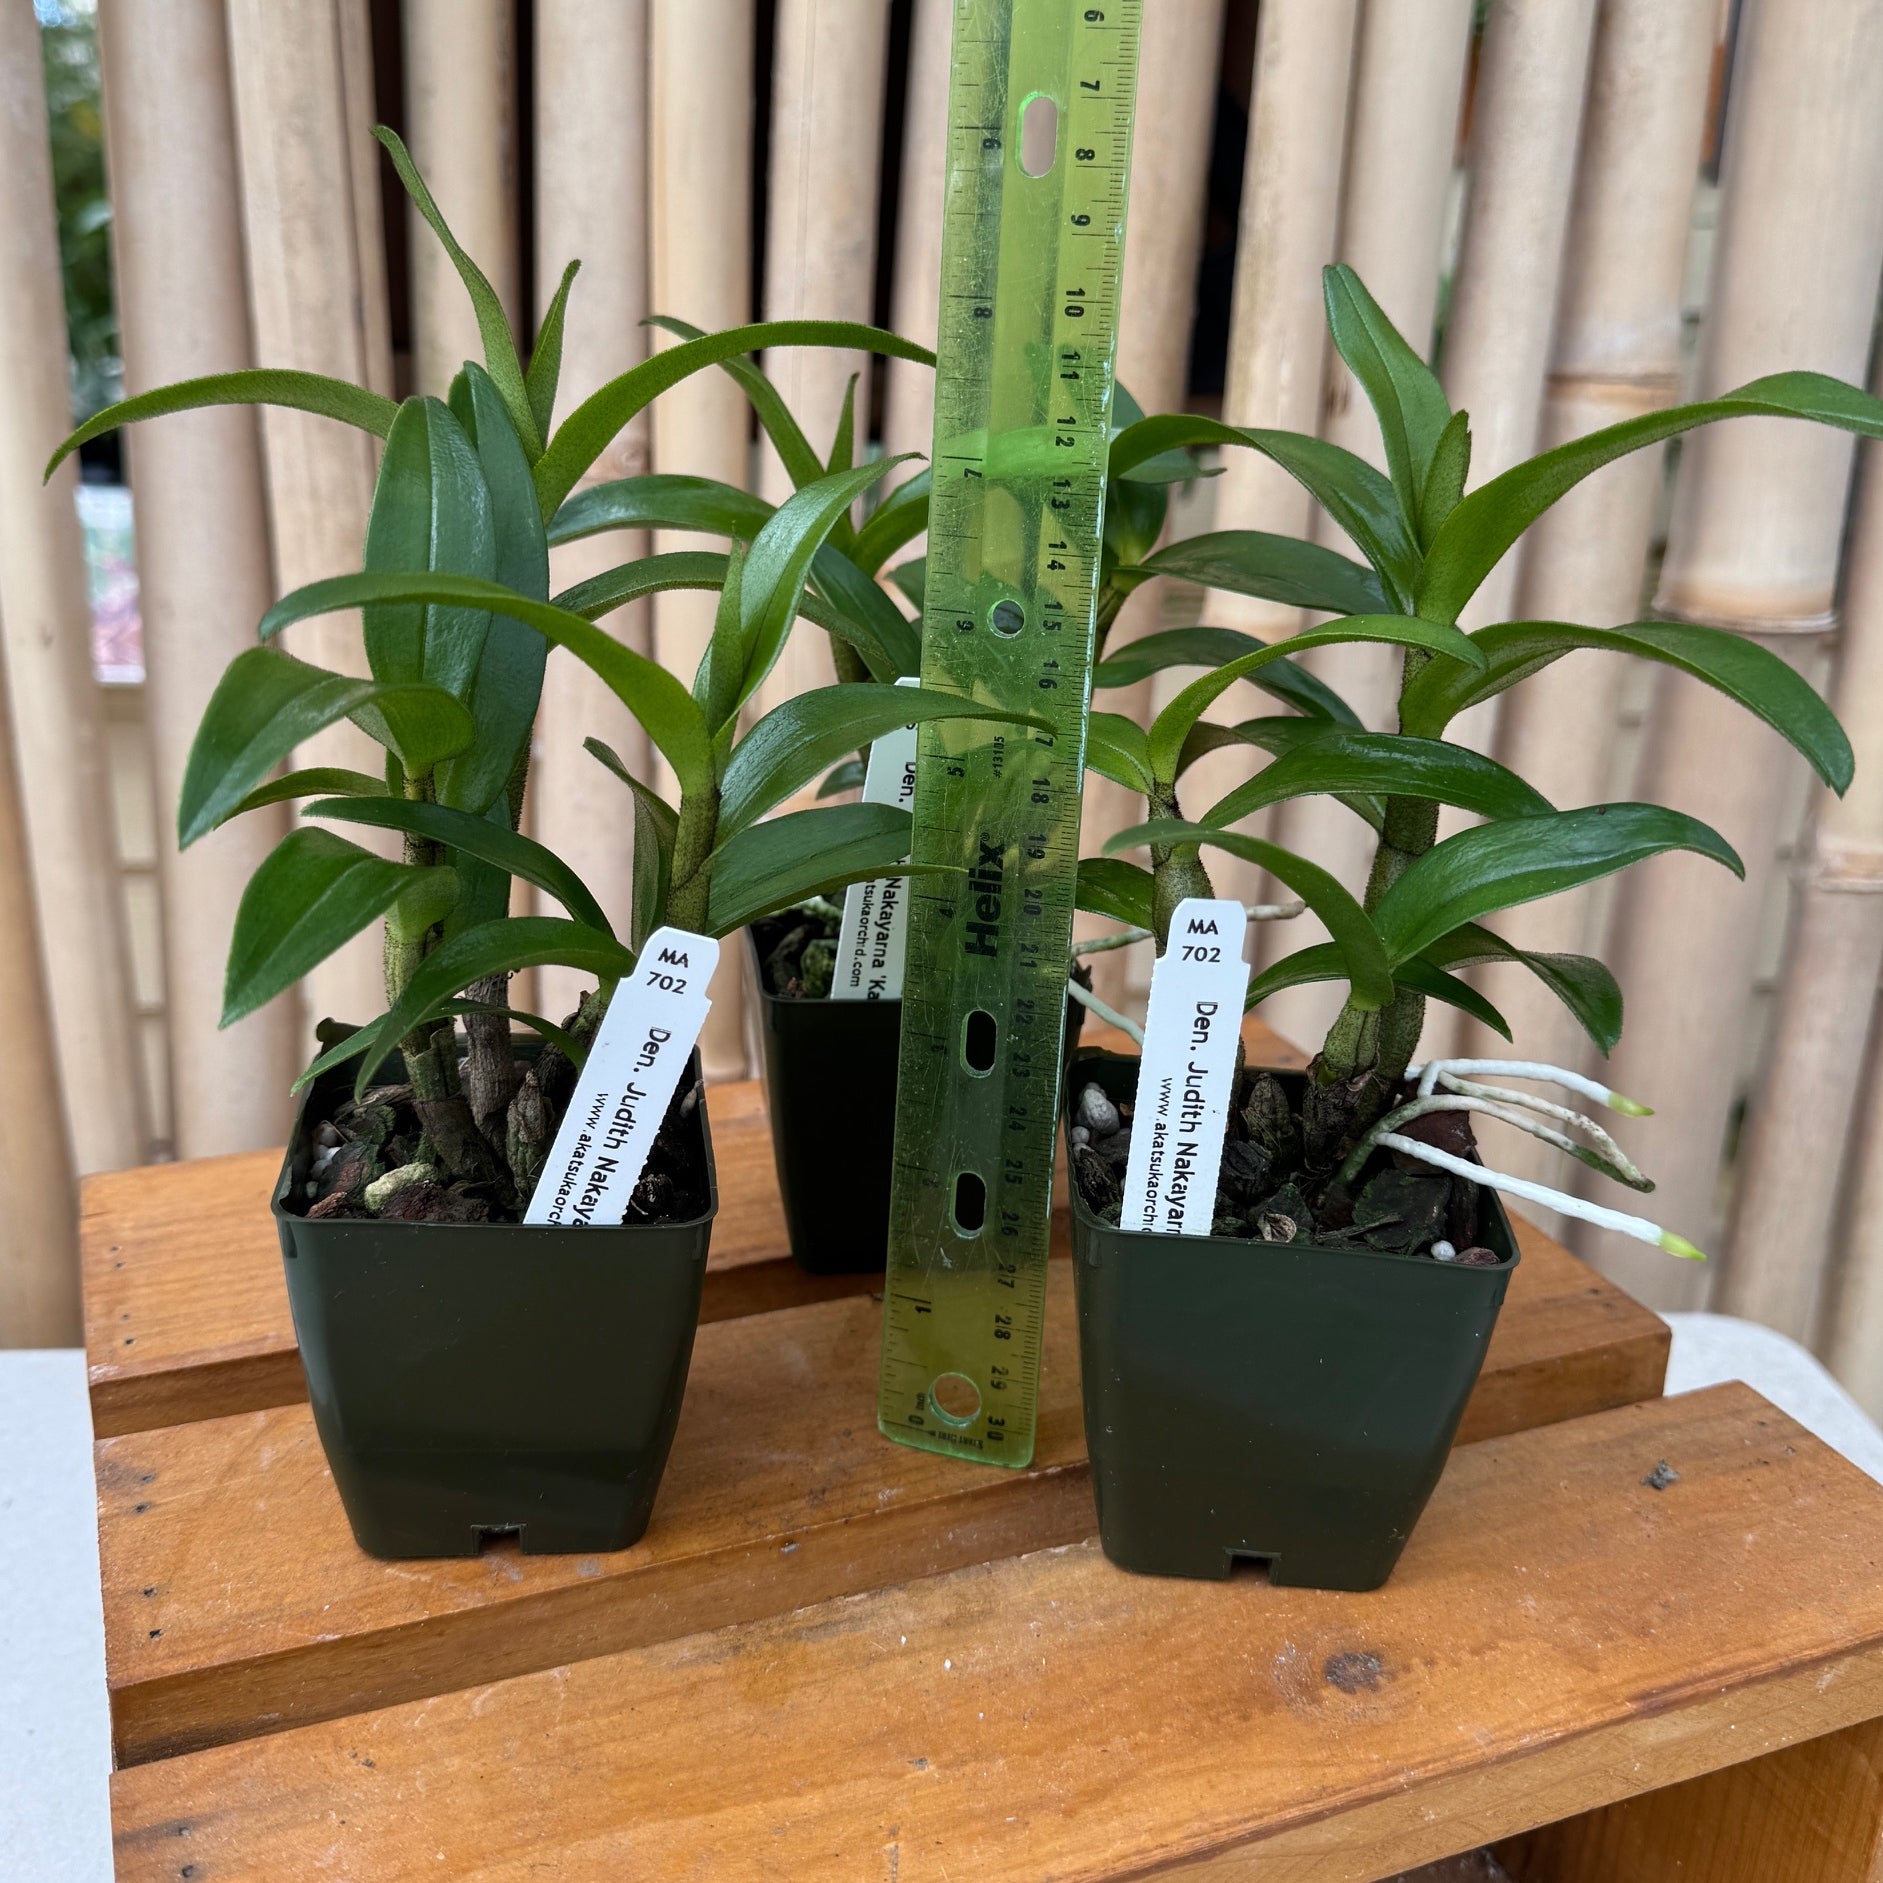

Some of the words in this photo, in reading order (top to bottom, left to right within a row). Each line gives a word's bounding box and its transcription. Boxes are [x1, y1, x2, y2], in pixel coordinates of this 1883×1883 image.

[1084, 9, 1105, 22] 6
[1080, 80, 1100, 92] 7
[1075, 148, 1096, 161] 8
[1070, 214, 1091, 227] 9
[973, 307, 993, 319] 8
[1064, 287, 1086, 318] 10
[1060, 351, 1081, 381] 11
[1055, 416, 1076, 448] 12
[963, 467, 983, 478] 7
[1051, 479, 1071, 510] 13
[1047, 541, 1068, 570] 14
[1042, 601, 1063, 632] 15
[1038, 660, 1059, 690] 16
[947, 766, 965, 778] 5
[1031, 778, 1050, 804] 18
[1027, 834, 1047, 860] 19
[1022, 888, 1043, 916] 20
[1186, 918, 1219, 935] MA
[658, 947, 690, 968] MA
[1019, 943, 1040, 969] 21
[1181, 945, 1221, 963] 702
[645, 971, 688, 995] 702
[1190, 1001, 1219, 1052] Den.
[633, 1026, 672, 1073] Den.
[1178, 1060, 1209, 1134] Judith
[602, 1081, 647, 1150] Judith
[1008, 1105, 1027, 1132] 24
[1004, 1158, 1024, 1185] 25
[1000, 1211, 1020, 1237] 26
[997, 1263, 1017, 1289] 27
[914, 1301, 932, 1315] 1
[993, 1314, 1013, 1341] 28
[986, 1415, 1005, 1442] 30
